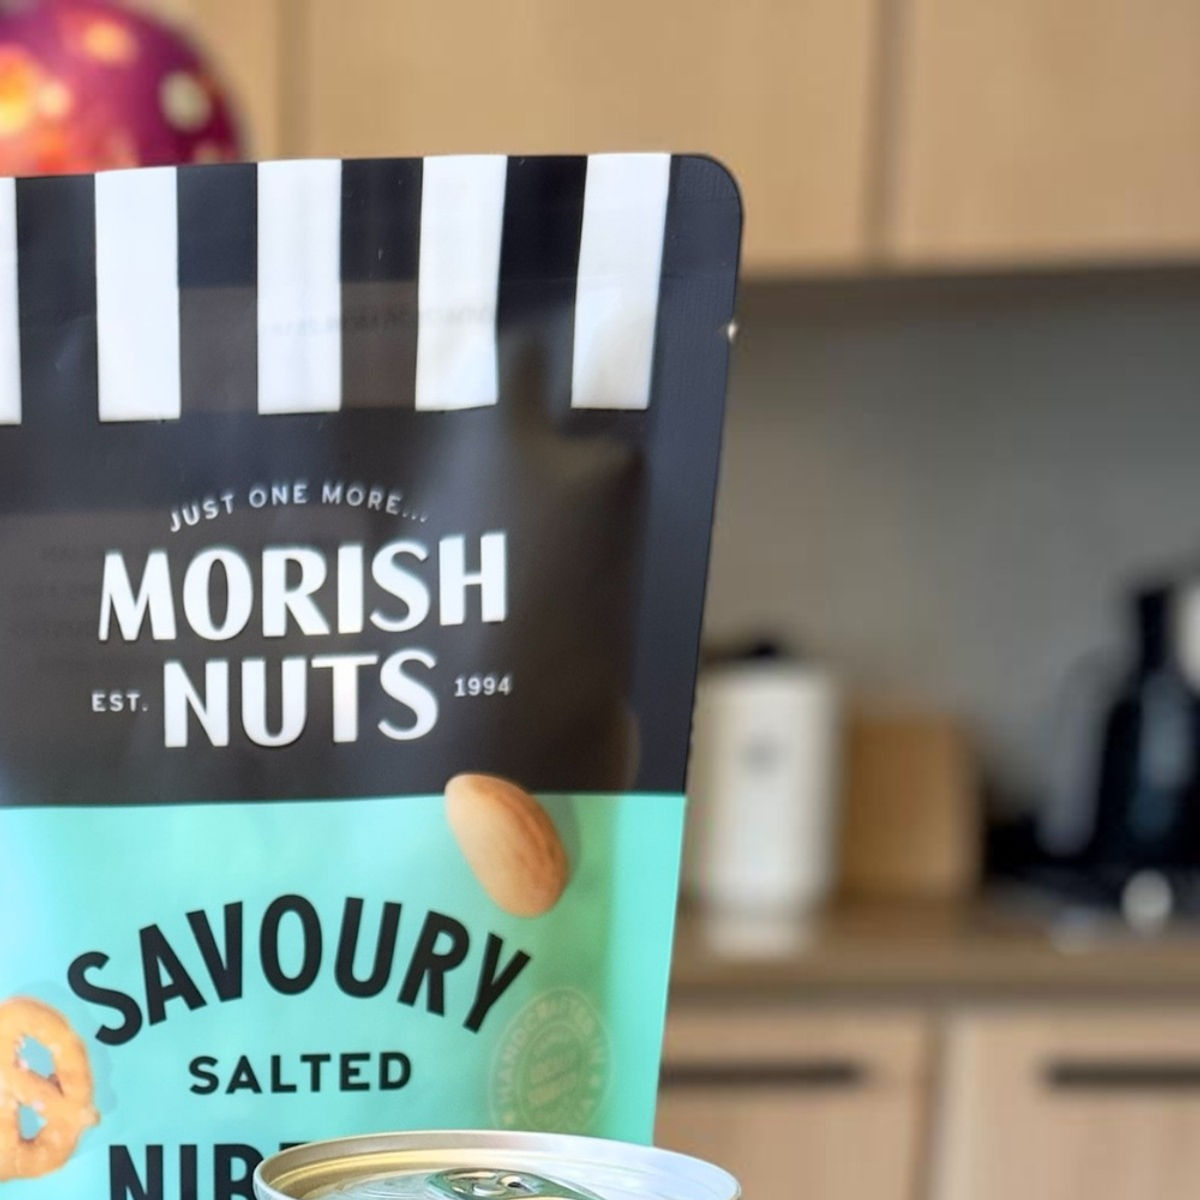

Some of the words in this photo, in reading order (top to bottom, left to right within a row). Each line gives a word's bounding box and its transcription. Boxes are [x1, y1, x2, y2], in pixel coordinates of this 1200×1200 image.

[170, 493, 235, 532] JUST
[248, 482, 309, 508] ONE
[98, 530, 506, 642] MORISH
[92, 690, 149, 713] EST.
[163, 649, 439, 748] NUTS
[453, 675, 512, 697] 1994
[66, 893, 532, 1047] SAVOURY
[187, 1051, 412, 1095] SALTED
